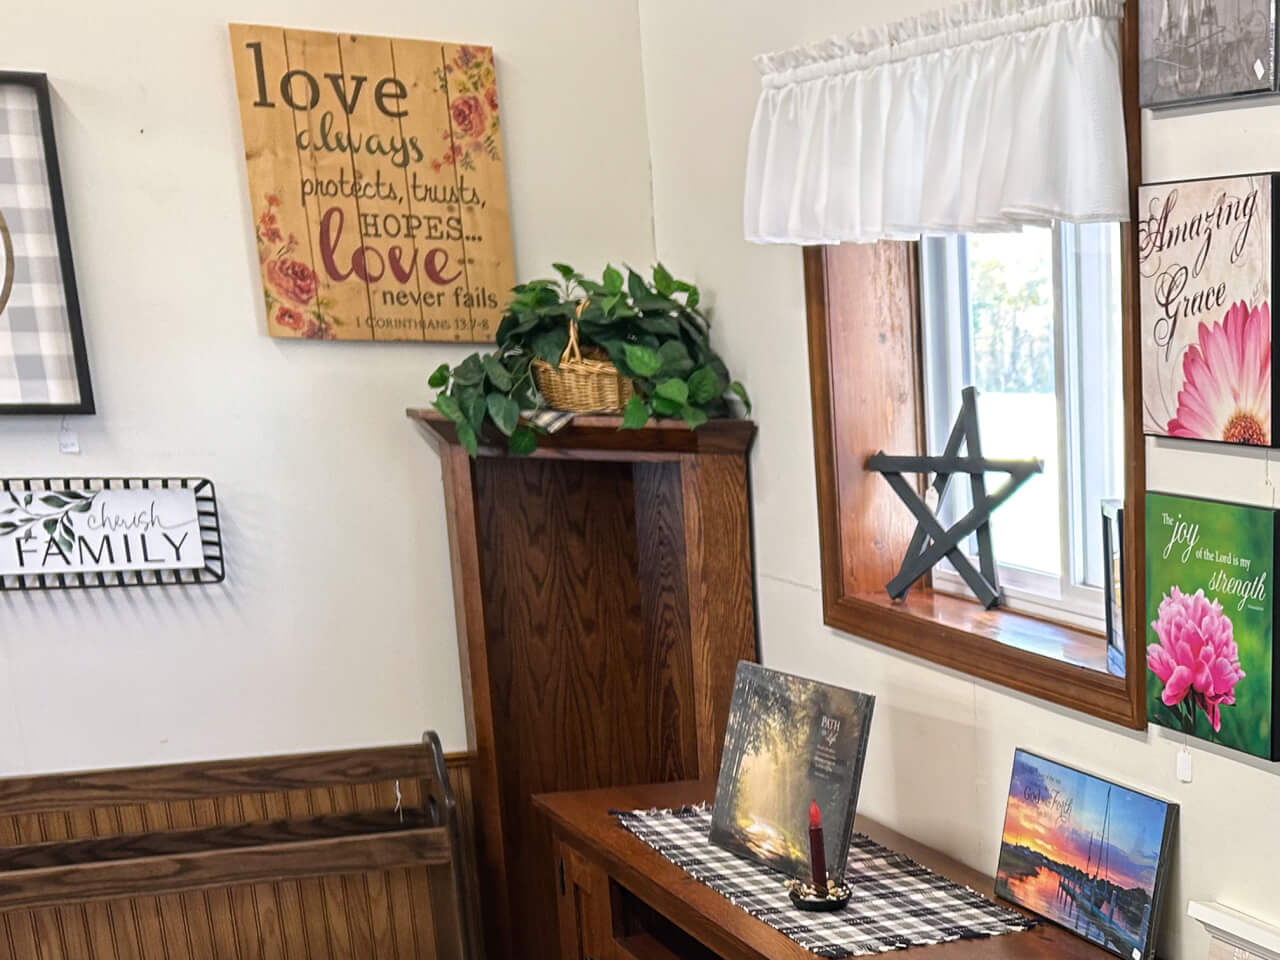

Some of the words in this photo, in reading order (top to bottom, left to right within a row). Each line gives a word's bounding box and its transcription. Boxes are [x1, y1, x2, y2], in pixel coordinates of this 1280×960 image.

[246, 42, 409, 118] love
[297, 111, 424, 169] always
[302, 168, 403, 207] protects,
[411, 172, 487, 209] trusts,
[320, 206, 464, 286] love
[360, 213, 483, 243] HOPES...
[1139, 187, 1259, 280] Amazing
[382, 289, 446, 307] never
[453, 286, 498, 309] fails
[1154, 265, 1227, 362] Grace
[88, 501, 180, 533] cherish
[1162, 512, 1174, 526] The
[15, 531, 189, 568] FAMILY
[1162, 513, 1201, 564] joy
[1196, 547, 1203, 558] of
[1203, 550, 1215, 562] the
[1215, 551, 1232, 565] Lord
[1232, 554, 1239, 565] is
[1239, 557, 1251, 572] my
[1208, 569, 1267, 611] strength
